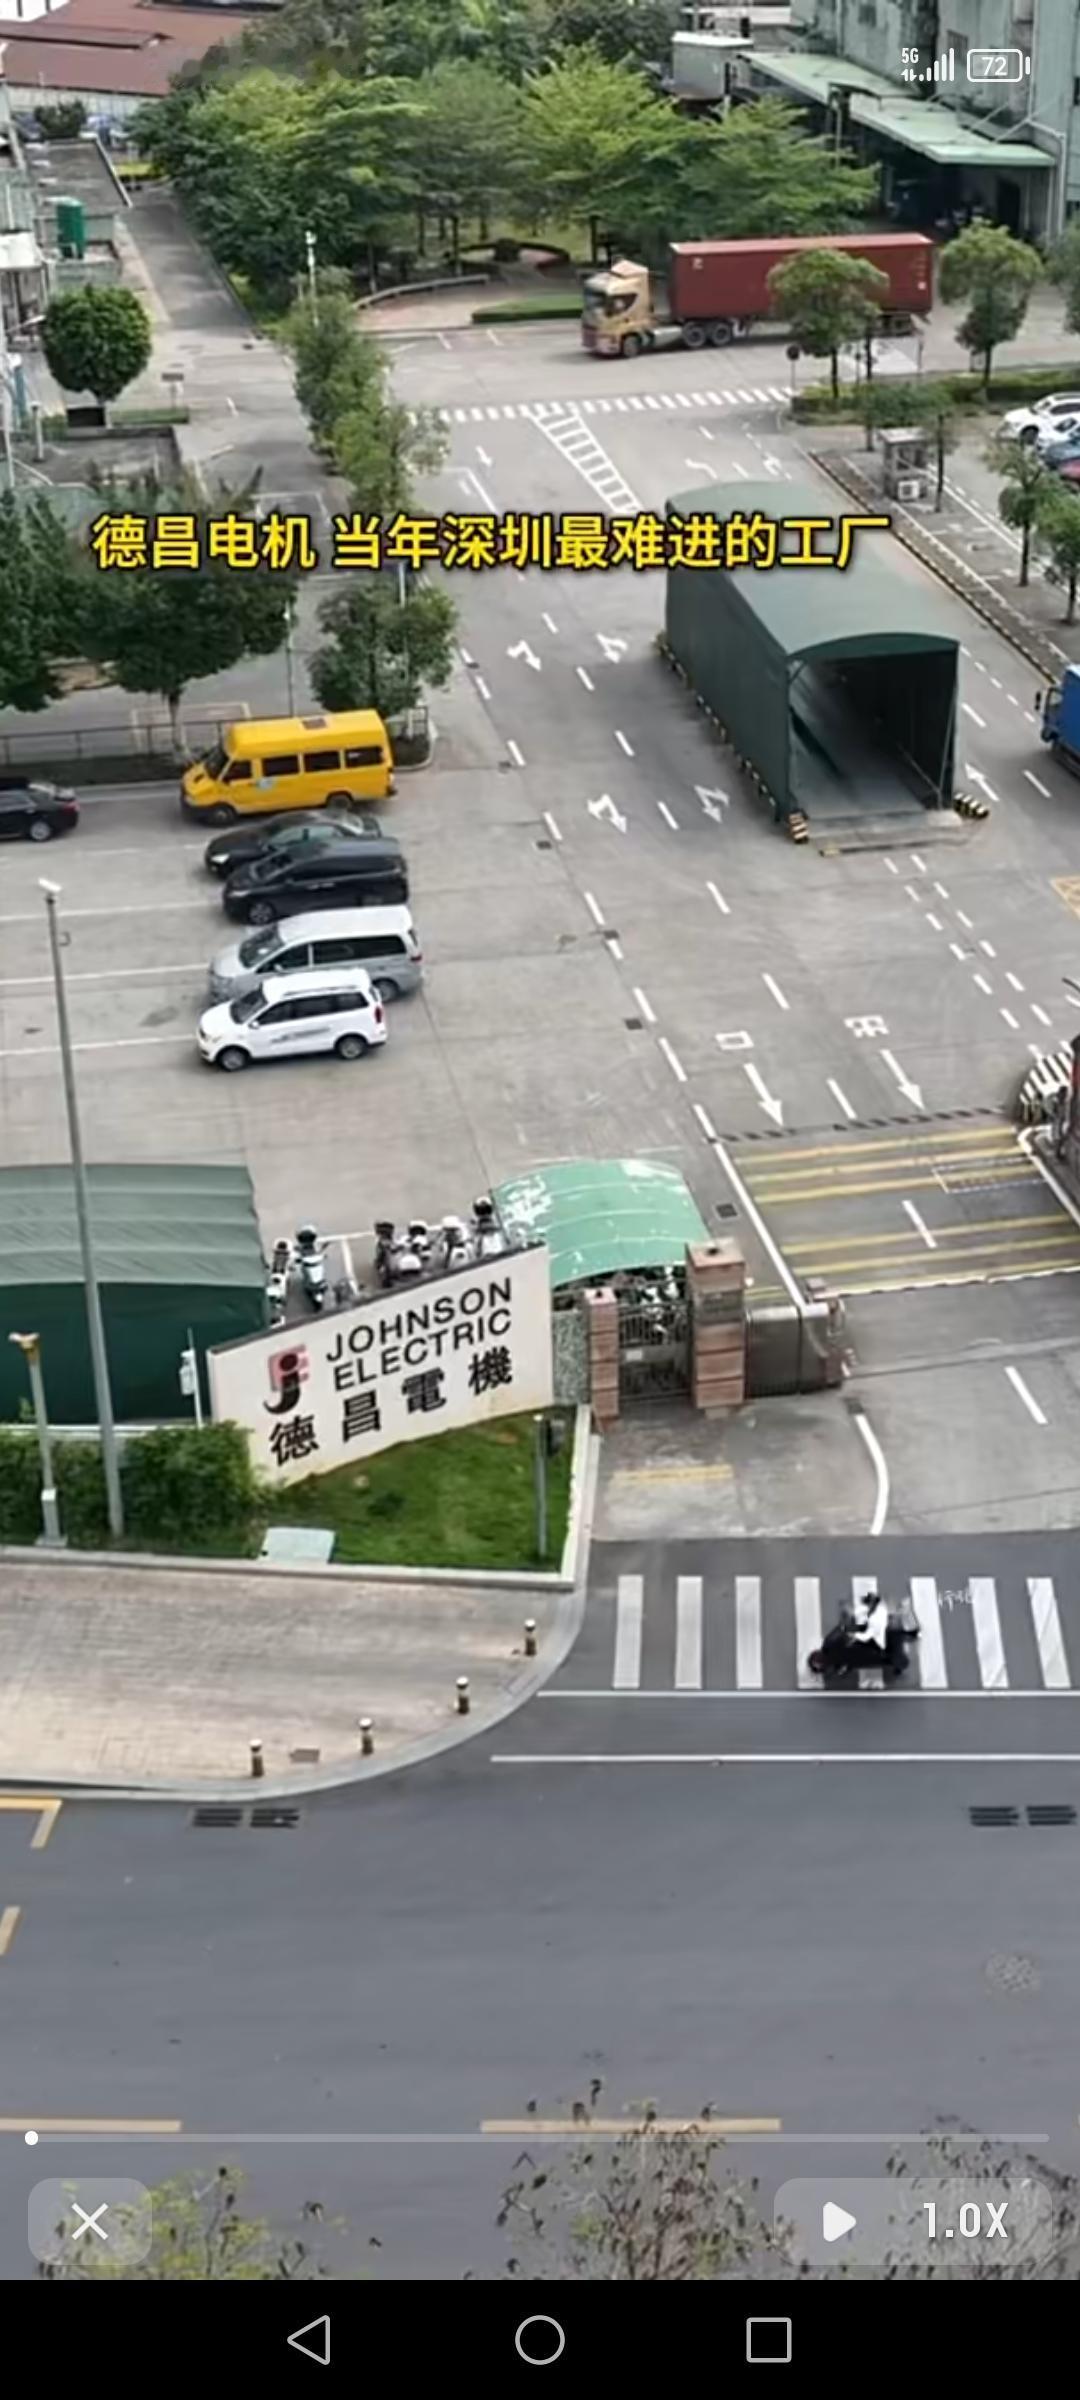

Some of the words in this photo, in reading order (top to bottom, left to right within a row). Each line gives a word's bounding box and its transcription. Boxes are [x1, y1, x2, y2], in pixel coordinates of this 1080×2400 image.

[326, 1277, 512, 1363] JOHNSON
[333, 1308, 512, 1392] ELECTRIC
[268, 1345, 513, 1467] 德昌電機
